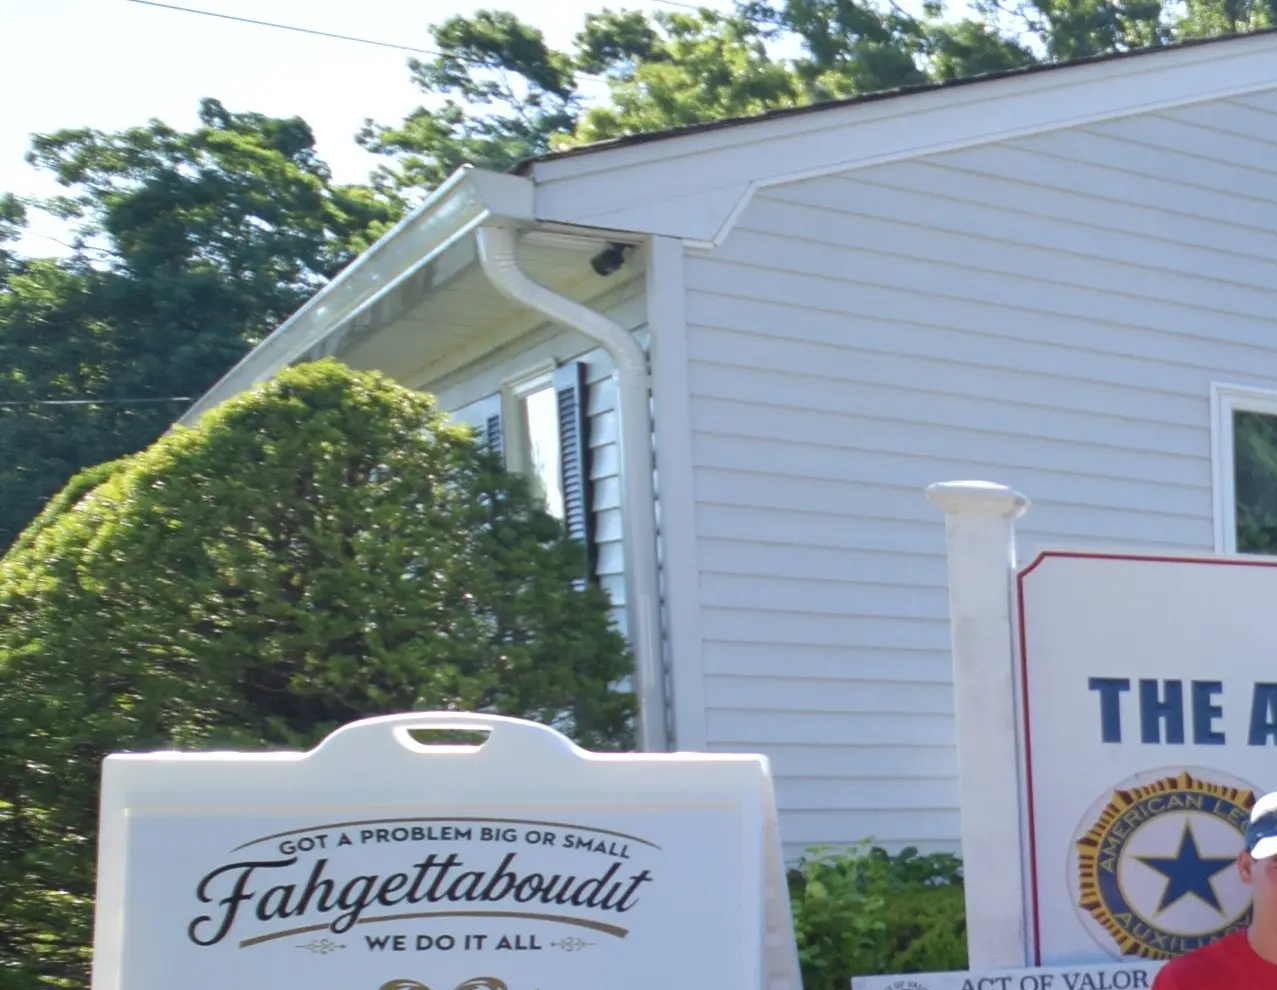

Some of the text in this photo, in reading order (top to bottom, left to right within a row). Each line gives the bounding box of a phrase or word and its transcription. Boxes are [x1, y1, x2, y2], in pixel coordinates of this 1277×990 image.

[1088, 677, 1226, 746] THE
[278, 827, 631, 860] GOT A PROBLEM BIG OR SMALL
[1101, 795, 1202, 873] AMERICAN
[187, 851, 654, 948] Fahgettaboudit
[365, 934, 542, 952] WE DO IT ALL
